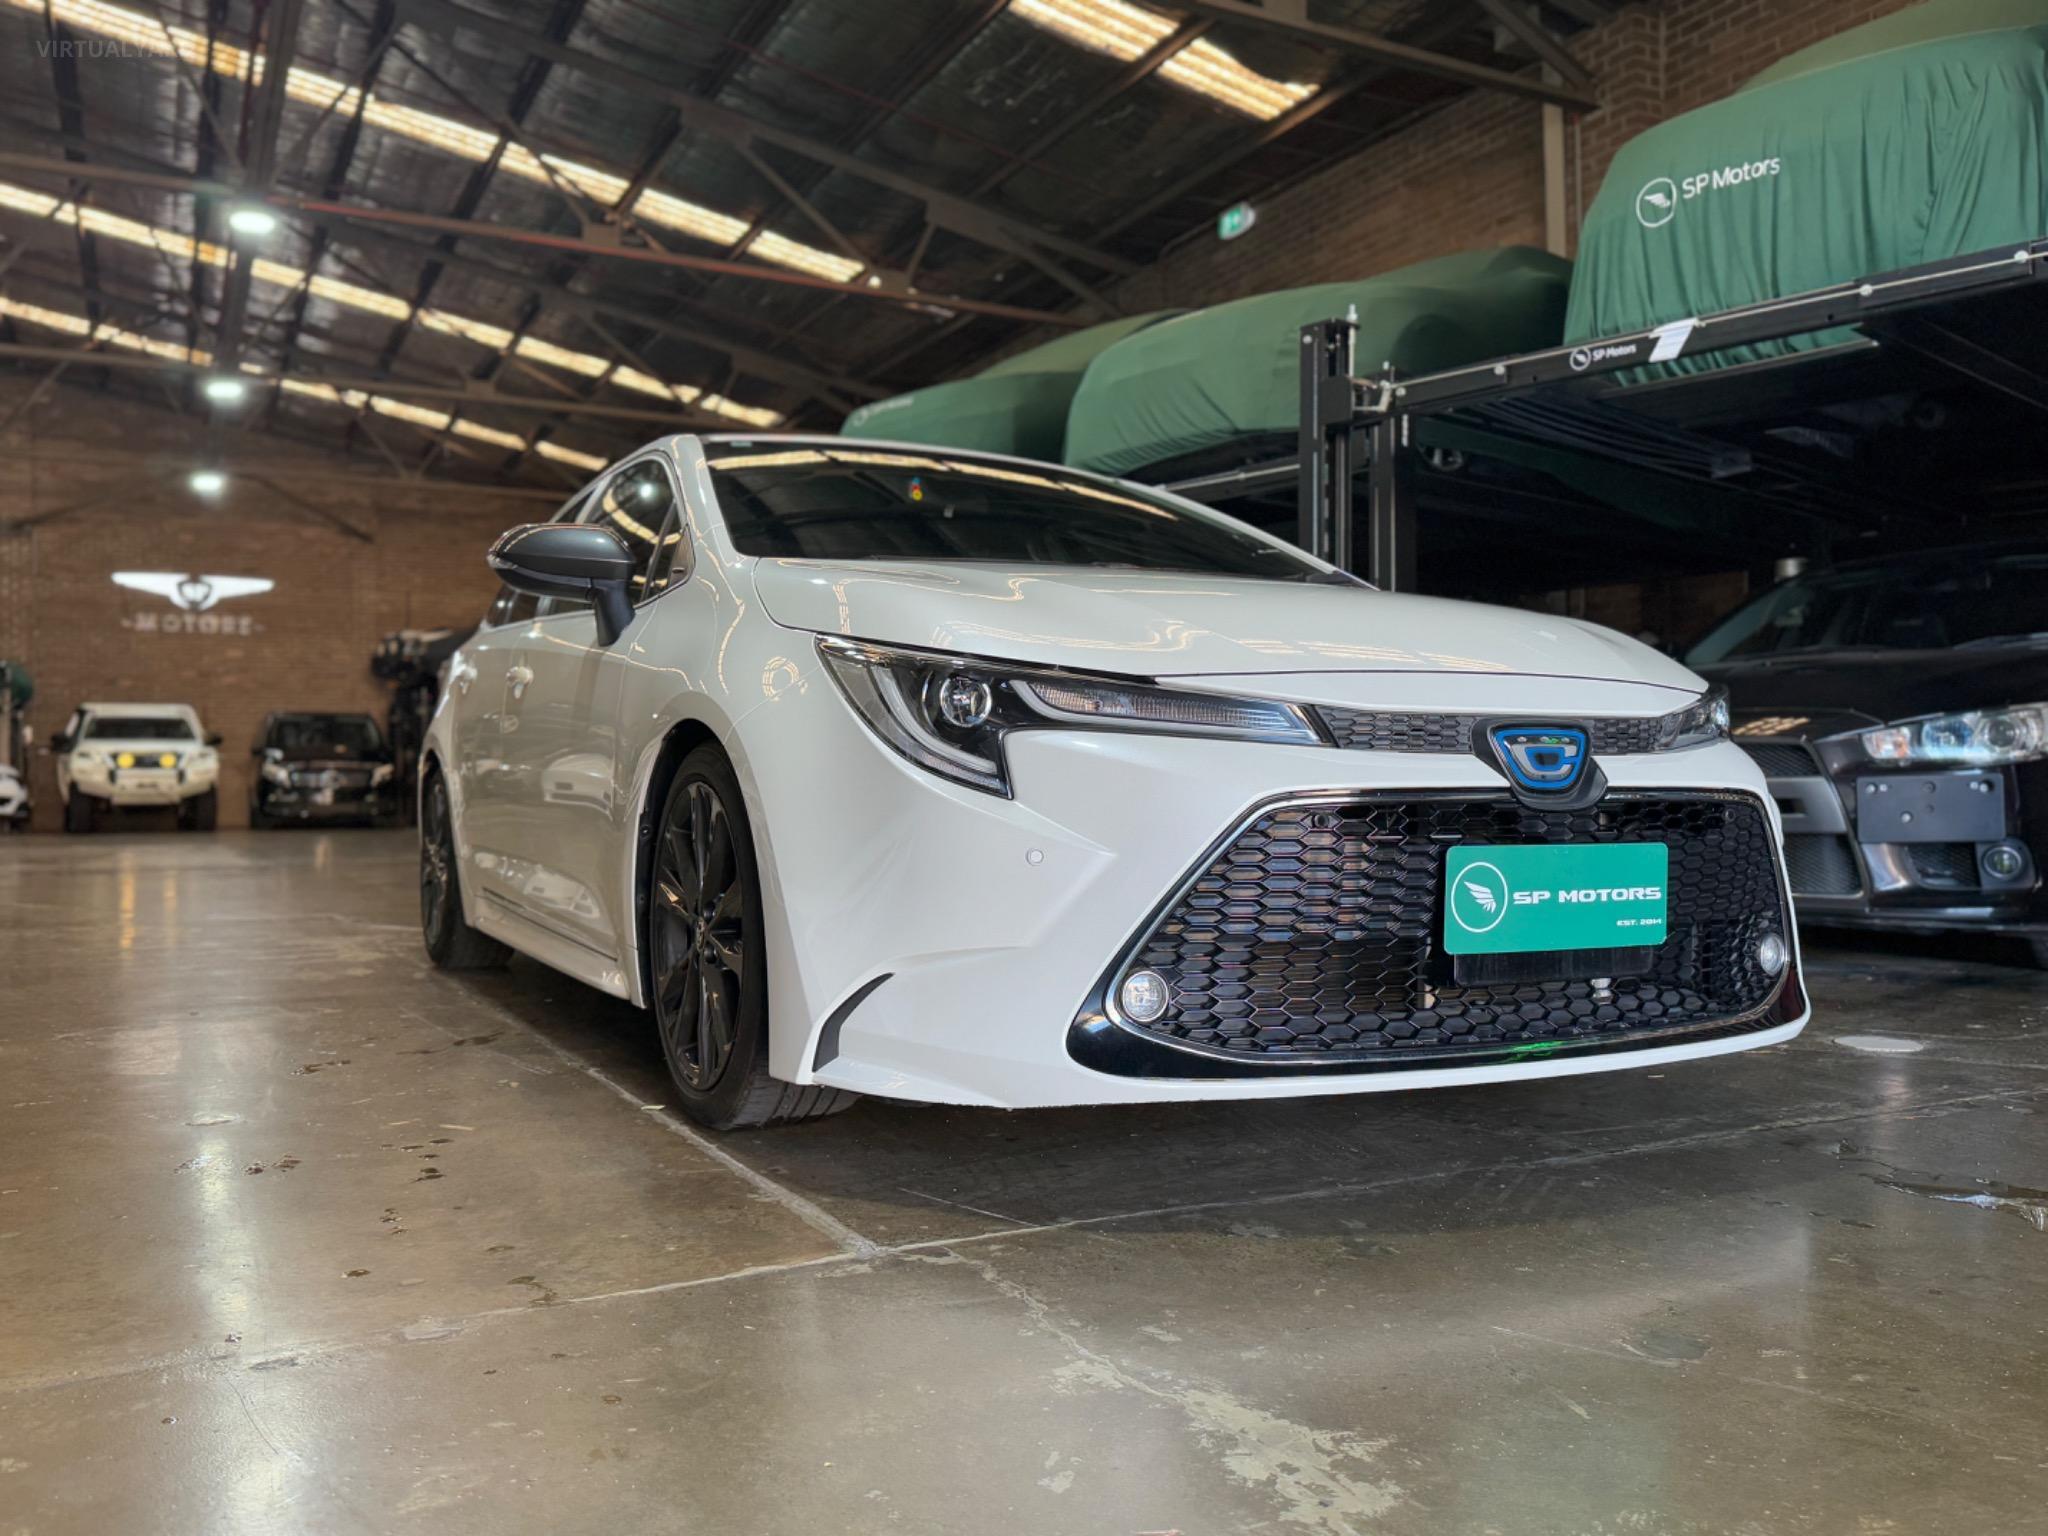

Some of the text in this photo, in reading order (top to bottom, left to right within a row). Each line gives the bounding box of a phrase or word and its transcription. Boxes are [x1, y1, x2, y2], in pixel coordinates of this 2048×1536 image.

[1682, 157, 1781, 199] SP Motors
[1513, 886, 1662, 905] SP MOTORS
[1616, 917, 1662, 926] EST. 2014
